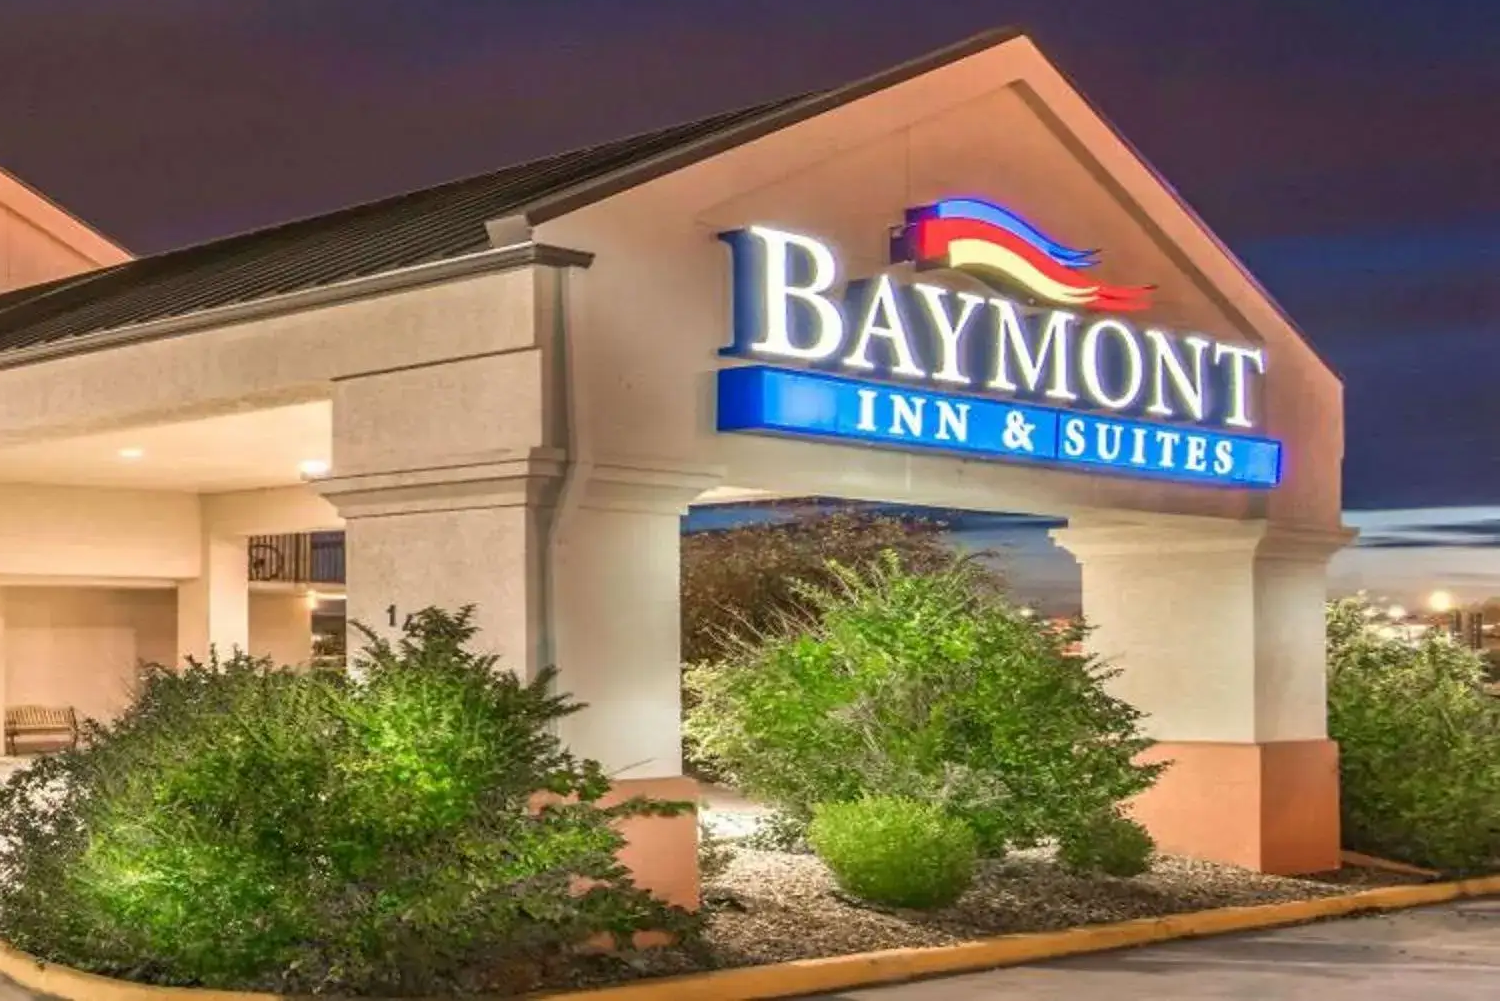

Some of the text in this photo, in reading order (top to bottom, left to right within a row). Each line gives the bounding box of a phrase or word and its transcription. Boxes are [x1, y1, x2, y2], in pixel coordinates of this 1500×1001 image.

[751, 226, 1264, 428] BAYMONT
[857, 389, 1234, 474] INN & SUITES
